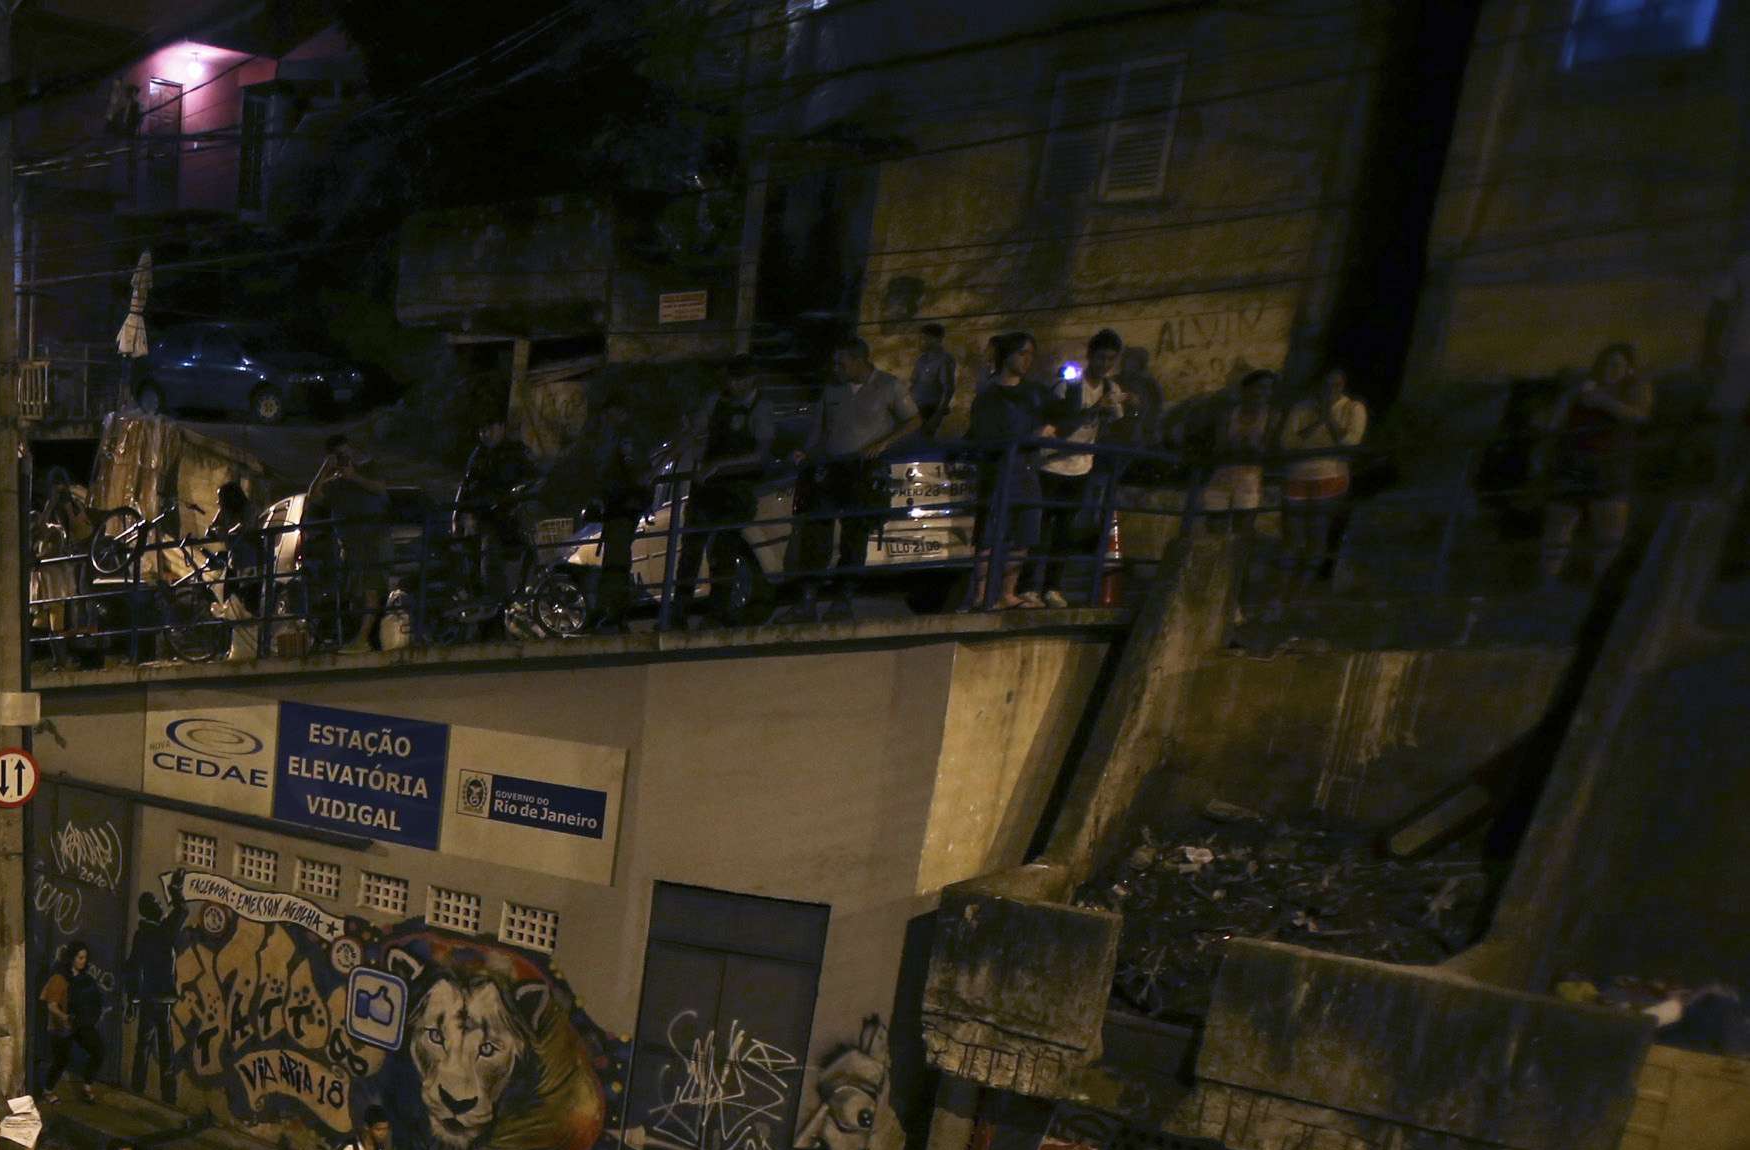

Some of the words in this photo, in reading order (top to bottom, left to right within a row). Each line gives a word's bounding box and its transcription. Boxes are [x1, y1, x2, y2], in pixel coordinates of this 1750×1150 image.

[308, 722, 411, 758] ESTAÇÃO
[153, 752, 268, 788] CEDAE
[288, 755, 429, 799] ELEVATÓRIA
[306, 794, 402, 832] VIDIGAL
[493, 799, 517, 815] Rio
[520, 803, 538, 819] de
[540, 807, 598, 829] Janeiro
[495, 790, 535, 803] GOVERNO
[537, 797, 549, 806] DO
[236, 893, 282, 918] EMERSON
[318, 1076, 344, 1109] 18
